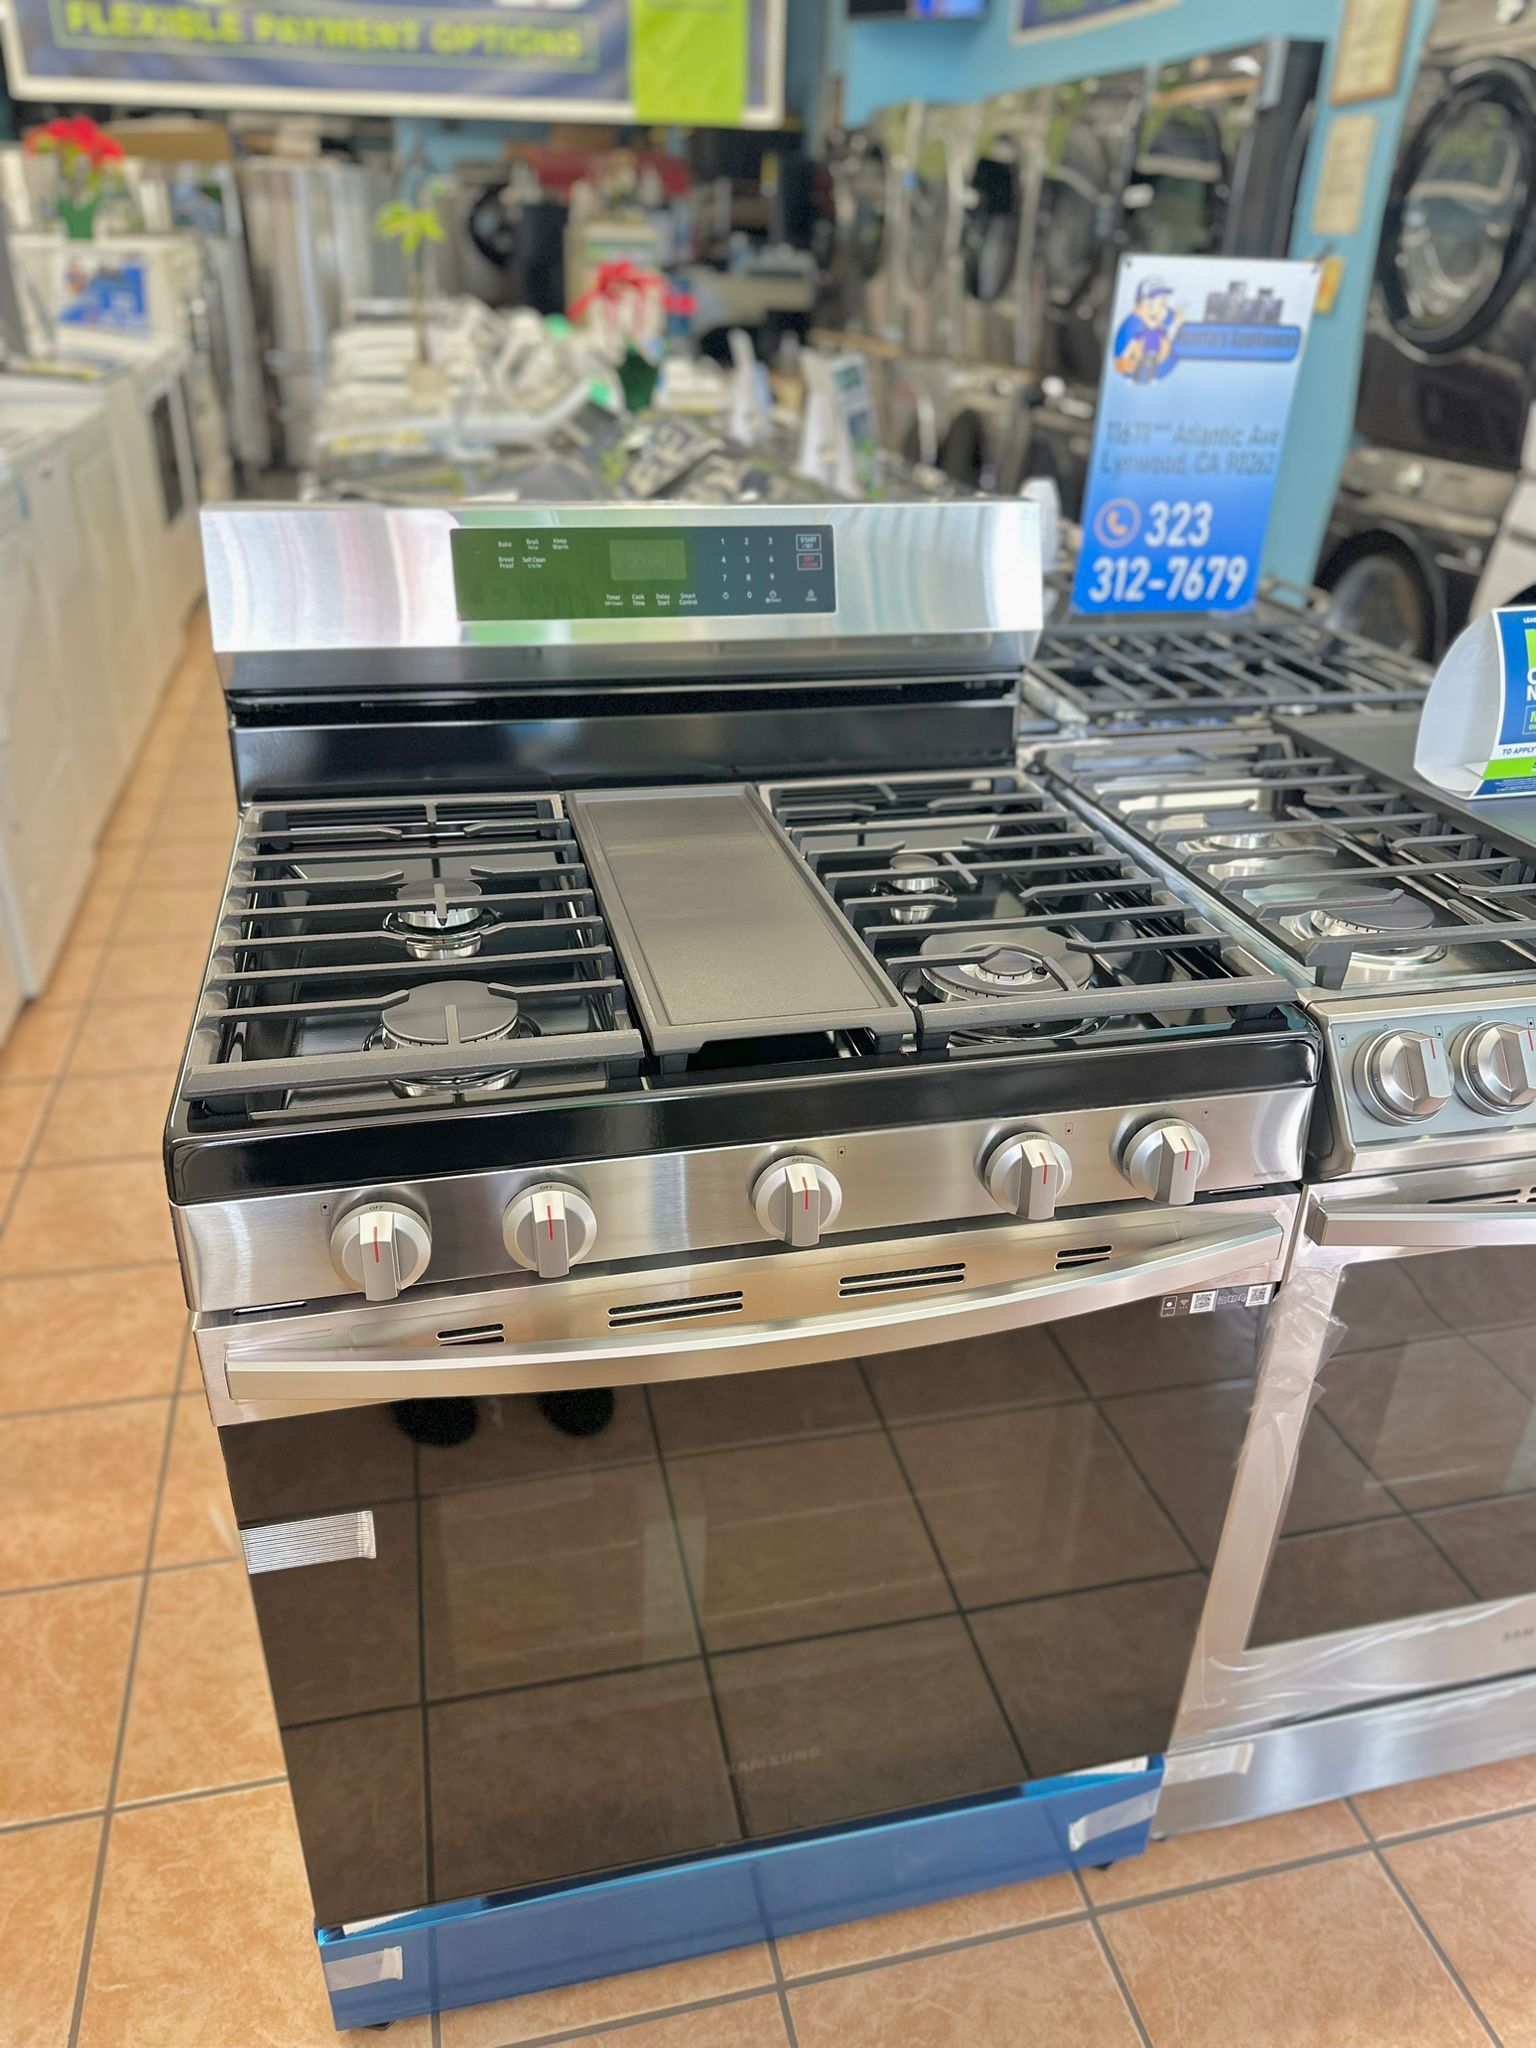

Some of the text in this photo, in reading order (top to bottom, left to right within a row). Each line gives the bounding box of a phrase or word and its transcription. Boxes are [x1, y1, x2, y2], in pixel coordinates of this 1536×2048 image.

[66, 2, 243, 43] FLEXIBLE
[253, 12, 420, 51] PAYMENT
[1172, 422, 1244, 447] Atlantic
[1248, 424, 1280, 447] Ave
[1196, 452, 1220, 475] CA
[1144, 501, 1213, 548] 323
[1088, 555, 1248, 603] 312-7679
[1513, 746, 1536, 754] APPLY
